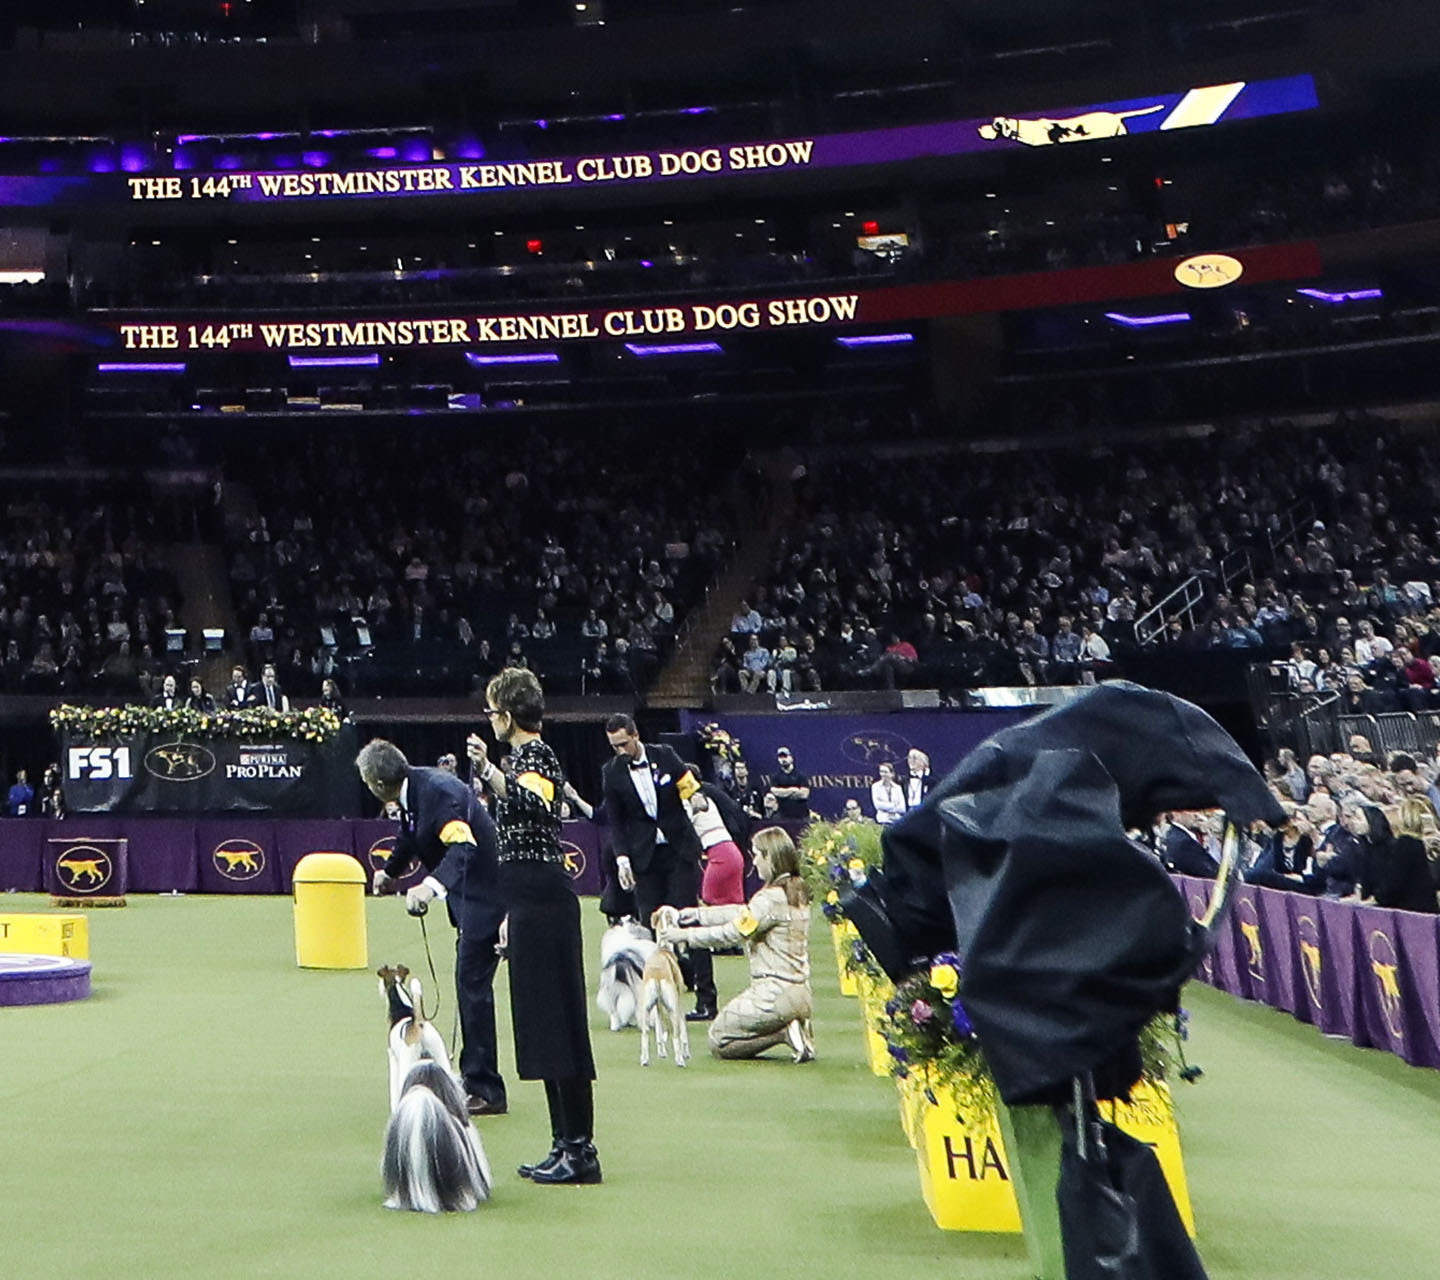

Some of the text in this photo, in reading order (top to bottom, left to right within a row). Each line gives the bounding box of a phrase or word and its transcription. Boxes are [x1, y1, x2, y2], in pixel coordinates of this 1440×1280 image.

[128, 140, 814, 199] THE 144TH WESTMINSTER KENNEL CLUB DOG SHOW
[120, 295, 859, 349] THE 144TH WESTMINSTER KENNEL CLUB DOG SHOW
[68, 746, 131, 780] FS1
